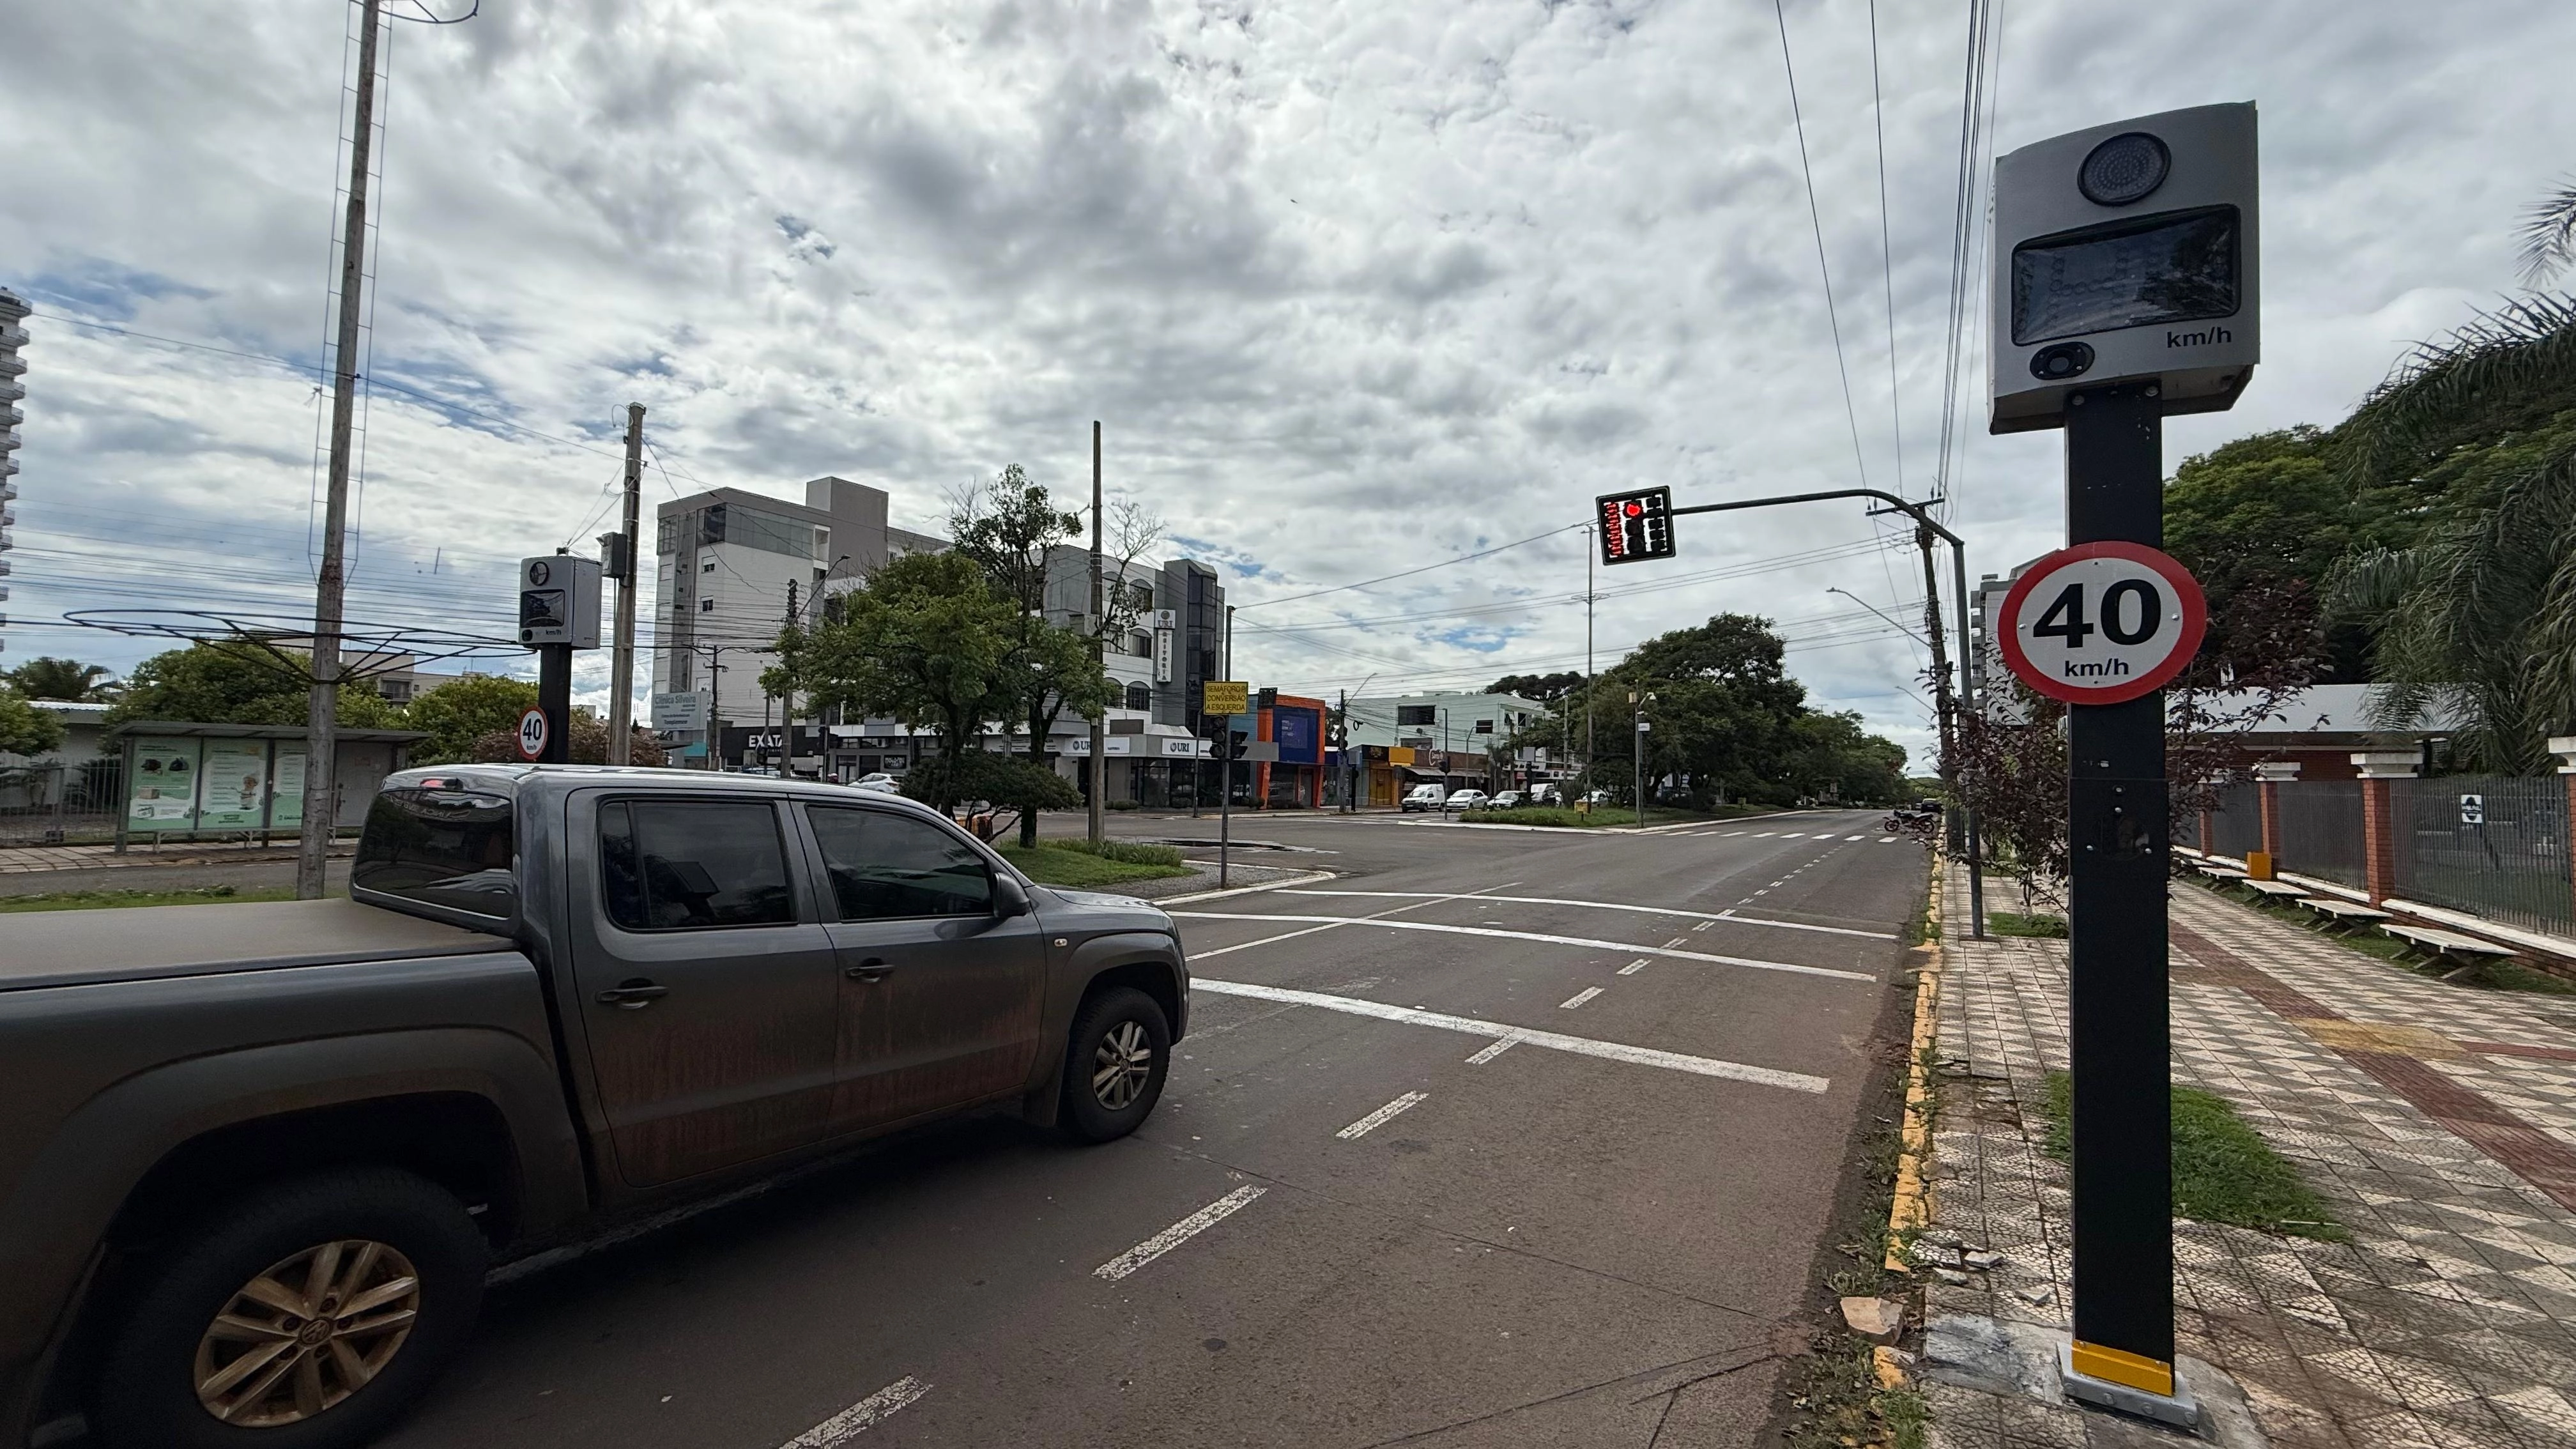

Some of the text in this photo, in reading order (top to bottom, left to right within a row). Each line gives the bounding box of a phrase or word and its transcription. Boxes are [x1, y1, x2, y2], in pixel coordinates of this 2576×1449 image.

[2166, 326, 2232, 348] km/h
[2033, 579, 2161, 648] 40
[2065, 658, 2129, 677] km/h
[523, 718, 542, 740] 40
[1177, 742, 1190, 753] URI
